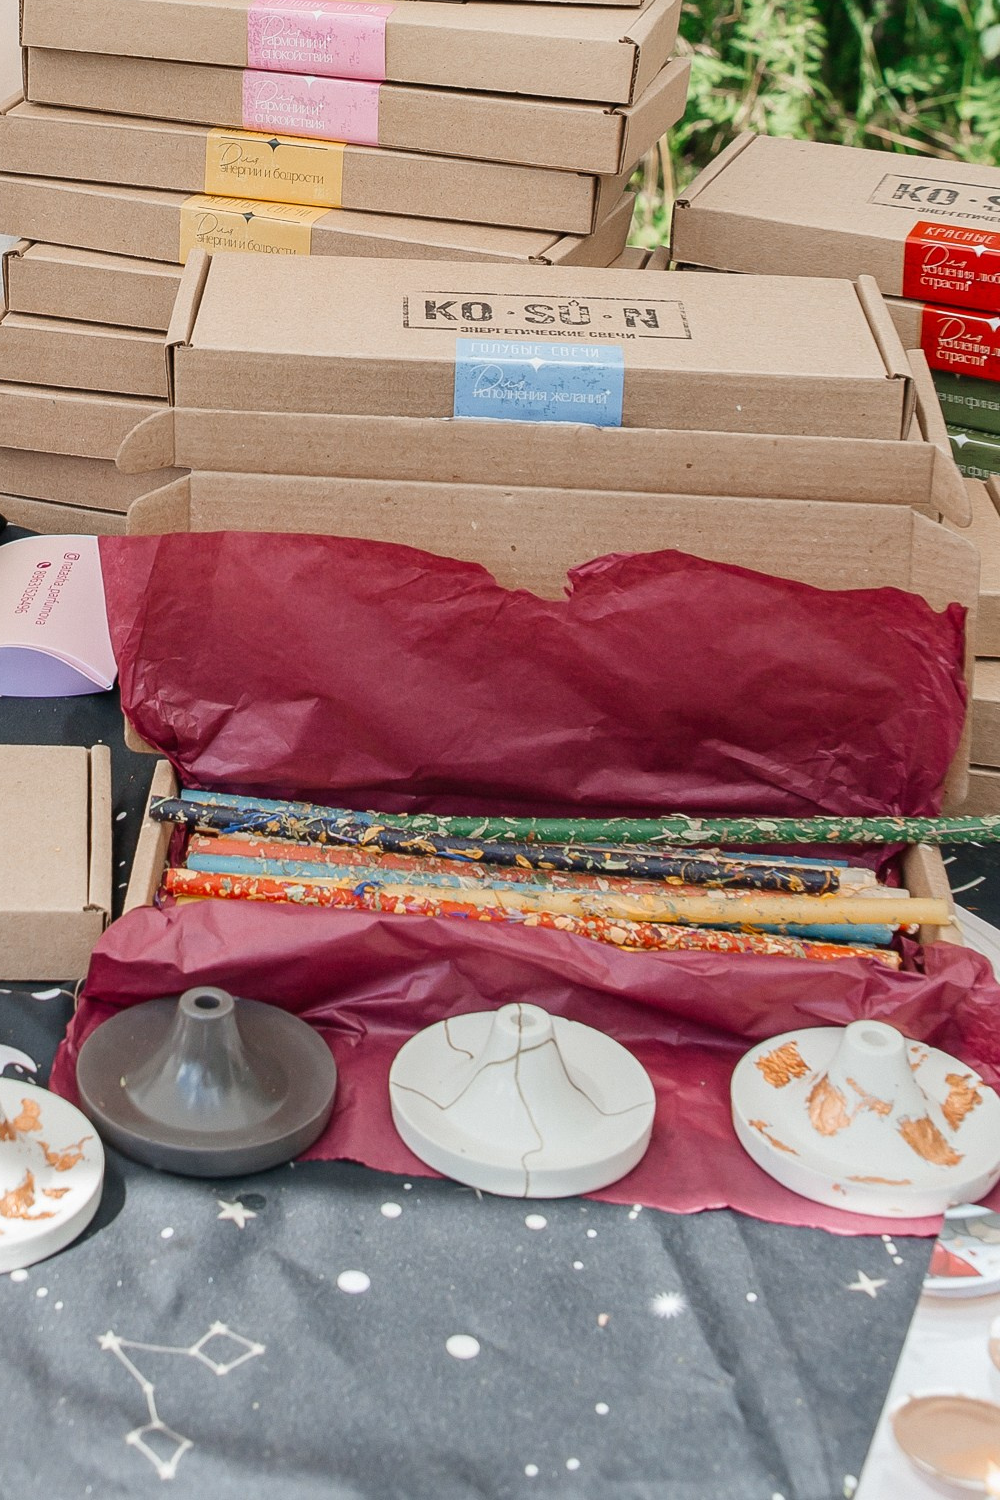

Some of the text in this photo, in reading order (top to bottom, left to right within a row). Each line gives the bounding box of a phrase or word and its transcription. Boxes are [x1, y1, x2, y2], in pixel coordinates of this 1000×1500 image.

[258, 15, 301, 41] Для
[261, 49, 333, 63] спокойствия
[252, 80, 295, 105] Для
[254, 114, 325, 130] спокойствия
[218, 142, 259, 167] Для
[220, 165, 262, 178] энергии
[273, 168, 324, 185] бодрости
[917, 207, 1000, 222] ЭНЕРГЕТИЧЕ
[195, 212, 234, 237] Для
[196, 234, 237, 248] энергии
[924, 227, 996, 245] КРАСНЫЕ
[920, 243, 968, 268] Для
[919, 276, 970, 292] страсти
[460, 326, 636, 340] ЭНЕРГЕТИЧЕСКИЕ СВЕЧИ
[936, 317, 983, 343] Для
[470, 342, 600, 358] ГОЛУБЫЕ СВЕЧИ
[935, 349, 985, 367] страсти
[469, 363, 525, 394] Для
[472, 388, 607, 405] исполнения желаний
